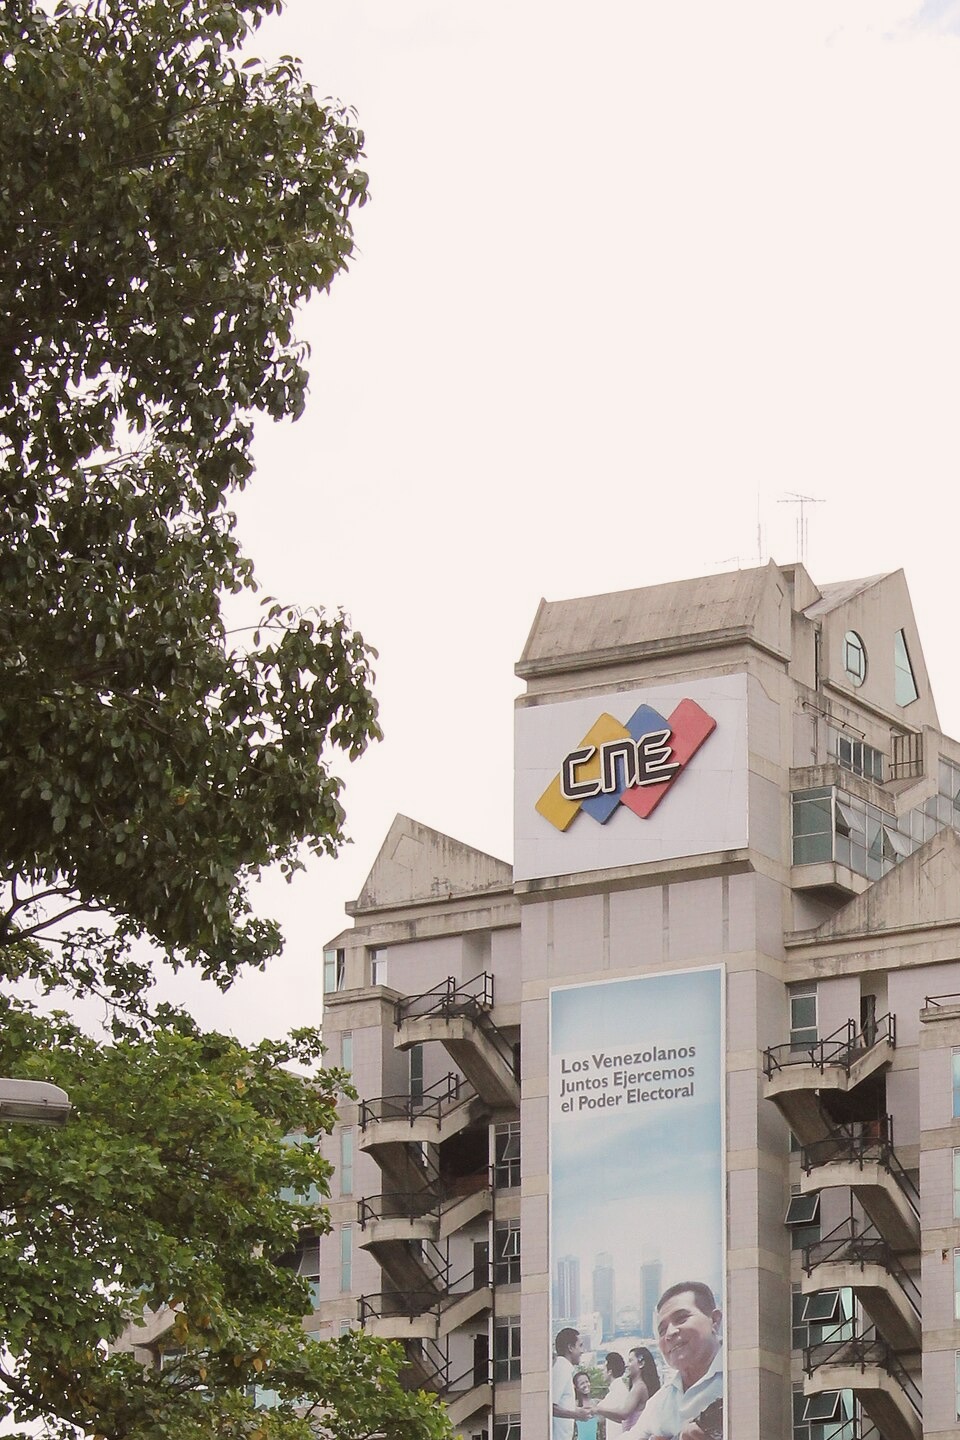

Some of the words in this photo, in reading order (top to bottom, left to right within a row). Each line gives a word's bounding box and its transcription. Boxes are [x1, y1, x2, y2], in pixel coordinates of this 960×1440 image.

[561, 1059, 589, 1074] Los
[592, 1046, 696, 1069] Venezolanos
[560, 1077, 608, 1097] Juntos
[613, 1066, 695, 1089] Ejercemos
[561, 1097, 573, 1112] el
[579, 1093, 622, 1110] Poder
[627, 1082, 694, 1104] Electoral
